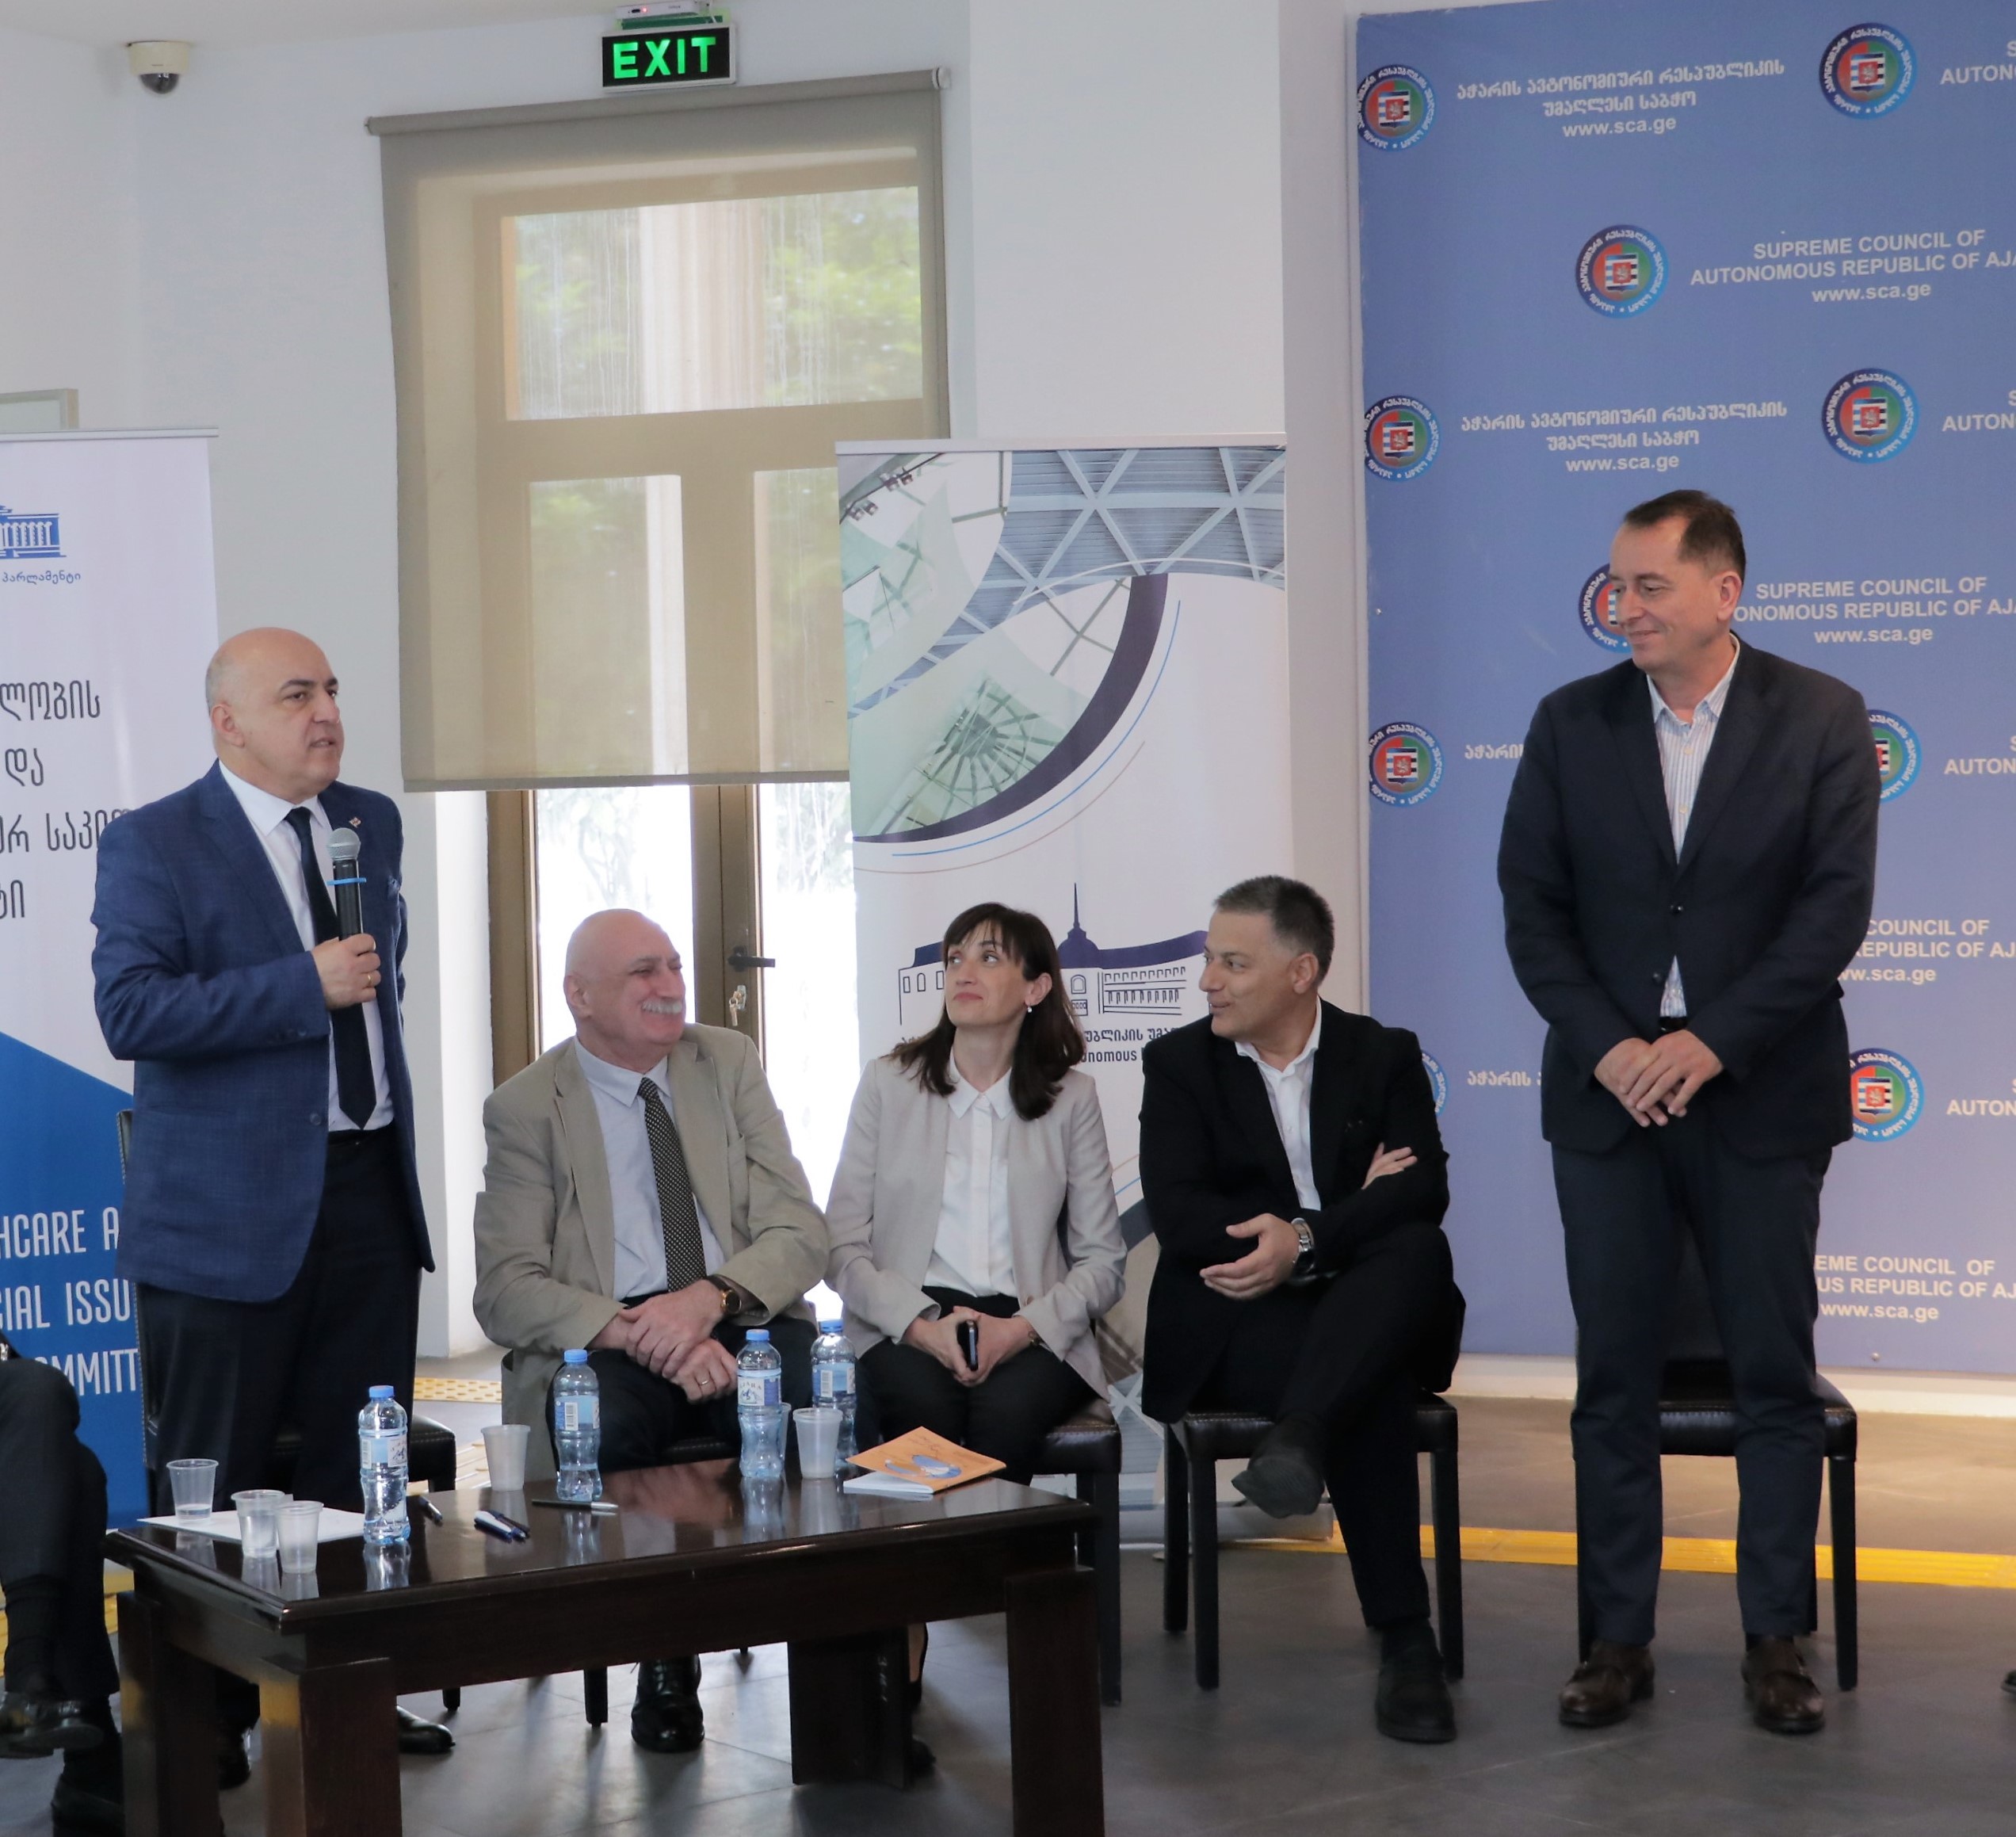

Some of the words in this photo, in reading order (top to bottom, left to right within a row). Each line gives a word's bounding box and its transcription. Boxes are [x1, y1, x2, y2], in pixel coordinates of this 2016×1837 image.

[613, 36, 716, 79] EXIT
[1457, 82, 1522, 100] აჭარის
[1527, 70, 1654, 94] ავტონომიური
[1659, 59, 1785, 84] რესპუბლიკის
[1940, 64, 2016, 85] AUTON
[1543, 94, 1635, 117] უმაღლესი
[1638, 90, 1697, 110] საბჭო
[1563, 116, 1677, 138] www.sca.ge
[1754, 238, 1853, 260] SUPREME
[1858, 232, 1951, 254] COUNCIL
[1956, 229, 1986, 246] OF
[1690, 262, 1836, 285] AUTONOMOUS
[1842, 254, 1945, 277] REPUBLIC
[1952, 252, 1980, 270] OF
[1984, 250, 2016, 268] AJ
[1812, 282, 1932, 303] www.sca.ge
[1461, 414, 1525, 431] აჭარის
[1531, 408, 1657, 429] ავტონომიური
[1662, 401, 1788, 422] რესპუბლიკის
[1546, 433, 1637, 452] უმაღლესი
[1642, 429, 1700, 448] საბჭო
[1566, 454, 1679, 472] www.sca.ge
[2, 570, 82, 585] პარლამენტი
[1756, 580, 1854, 600] SUPREME
[1860, 577, 1953, 597] COUNCIL
[1958, 576, 1987, 594] OF
[1844, 599, 1947, 620] REPUBLIC
[1953, 598, 1981, 616] OF
[1987, 598, 2016, 615] AJ
[1814, 625, 1933, 646] www.sca.ge
[5, 747, 44, 787] და
[0, 814, 30, 854] რ
[46, 808, 132, 852] საკი
[0, 879, 25, 920] ი
[1961, 918, 1990, 936] OF
[1956, 941, 1984, 958] OF
[1467, 1071, 1531, 1087] აჭარის
[1864, 1256, 1956, 1275] COUNCIL
[1966, 1258, 1995, 1276] OF
[1850, 1277, 1953, 1297] REPUBLIC
[1958, 1281, 1987, 1297] OF
[0, 1285, 51, 1331] IAL
[1819, 1303, 1939, 1323] www.sca.ge
